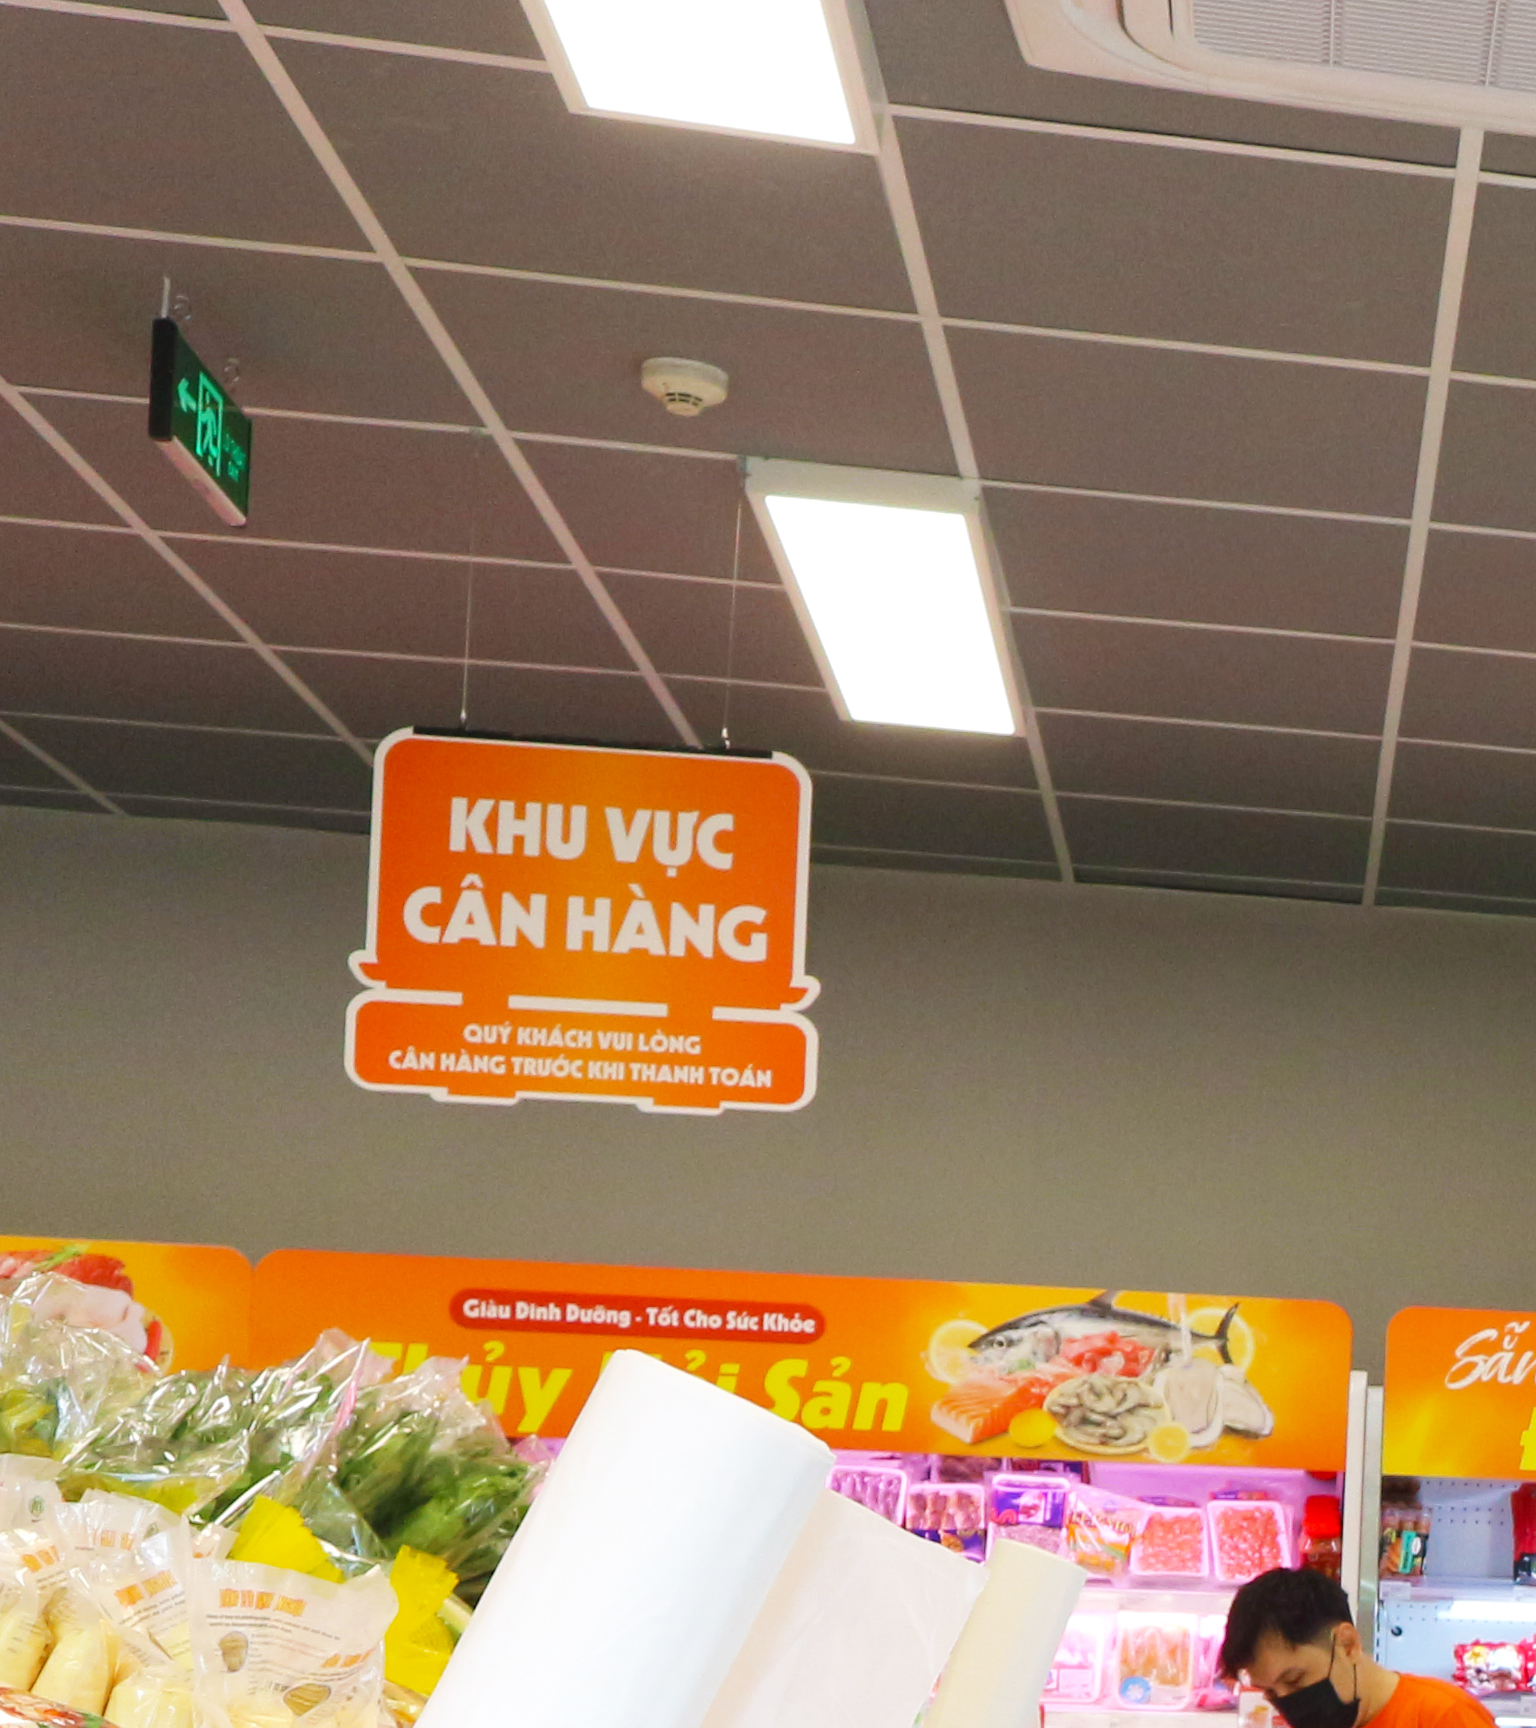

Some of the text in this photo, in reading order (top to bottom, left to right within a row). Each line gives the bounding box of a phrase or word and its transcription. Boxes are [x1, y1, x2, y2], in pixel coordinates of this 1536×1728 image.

[449, 797, 733, 876] KHU VỰC
[403, 874, 767, 961] CÂN HÀNG
[464, 1024, 701, 1054] QUÝ KHÁCH VUI LÒNG
[389, 1050, 435, 1070] CÂN
[441, 1049, 505, 1076] HÀNG
[587, 1061, 624, 1081] KHI
[631, 1063, 703, 1085] THANH
[710, 1064, 771, 1088] TOÁN
[462, 1298, 511, 1320] Giàu
[515, 1301, 562, 1322] Dinh
[646, 1305, 679, 1326] Tốt
[683, 1309, 722, 1330] Cho
[726, 1310, 759, 1331] Sức
[762, 1312, 815, 1334] Khỏe
